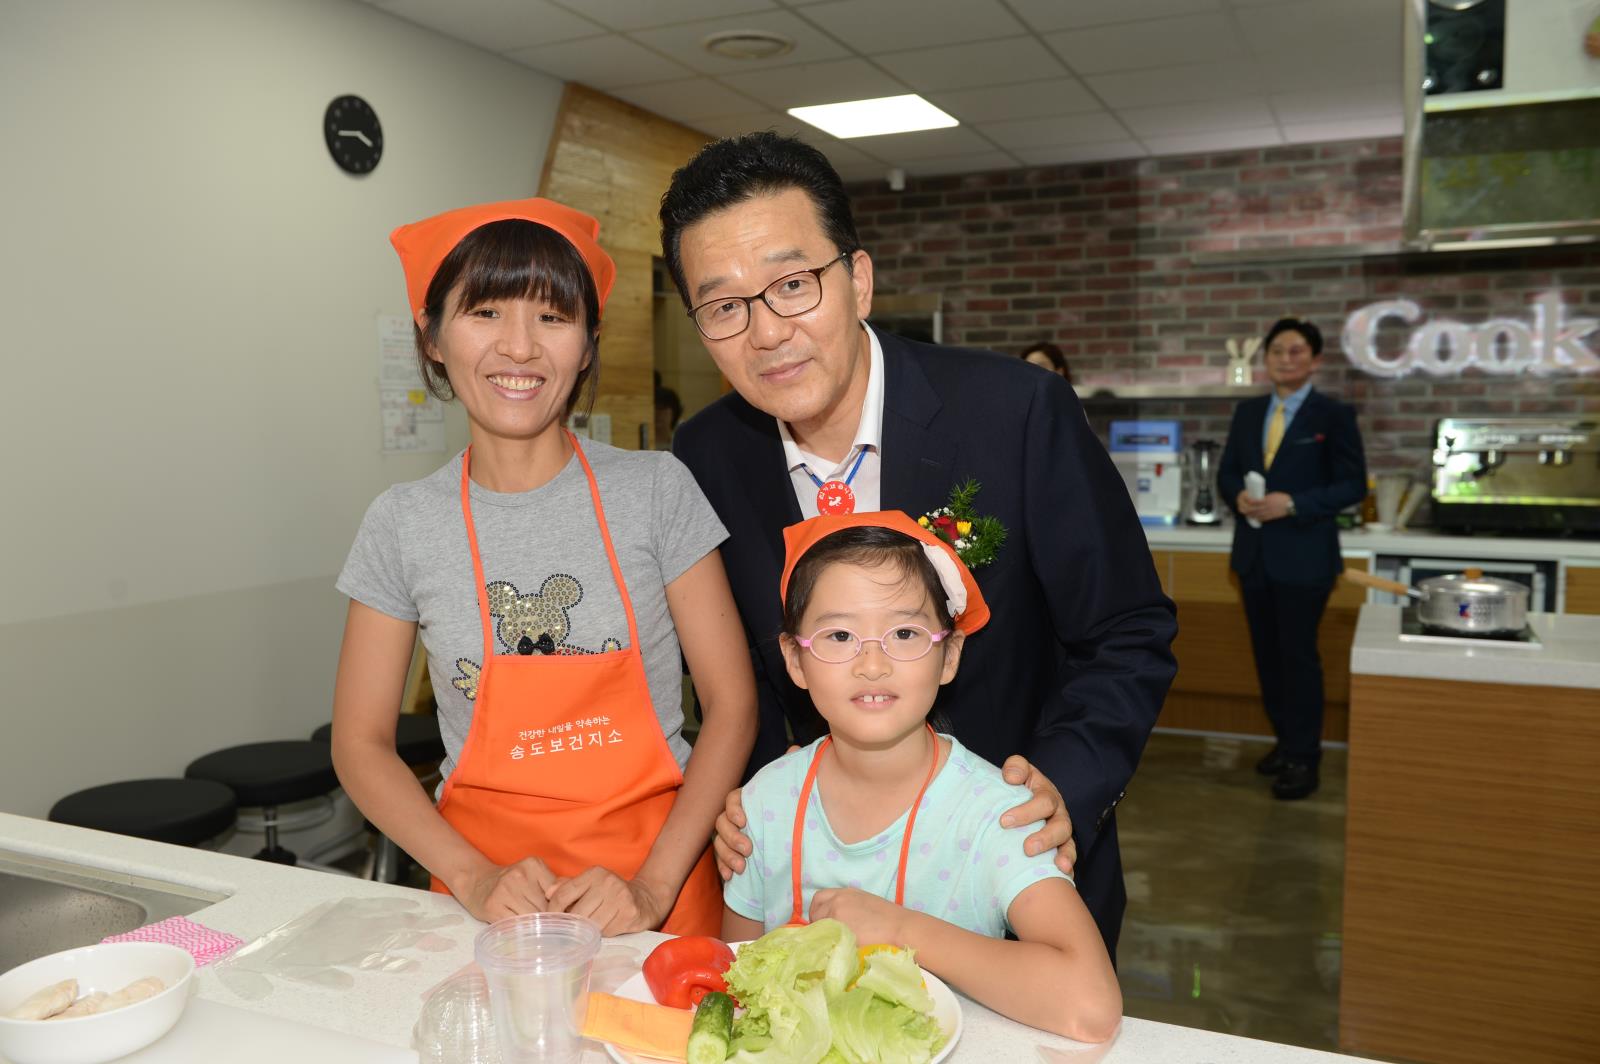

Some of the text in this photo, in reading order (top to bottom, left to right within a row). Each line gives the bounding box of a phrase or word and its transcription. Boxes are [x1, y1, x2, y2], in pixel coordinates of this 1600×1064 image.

[1341, 290, 1600, 378] Cook
[519, 715, 611, 741] 건강한 내일을 약속하는
[509, 729, 624, 760] 송도보건지소
